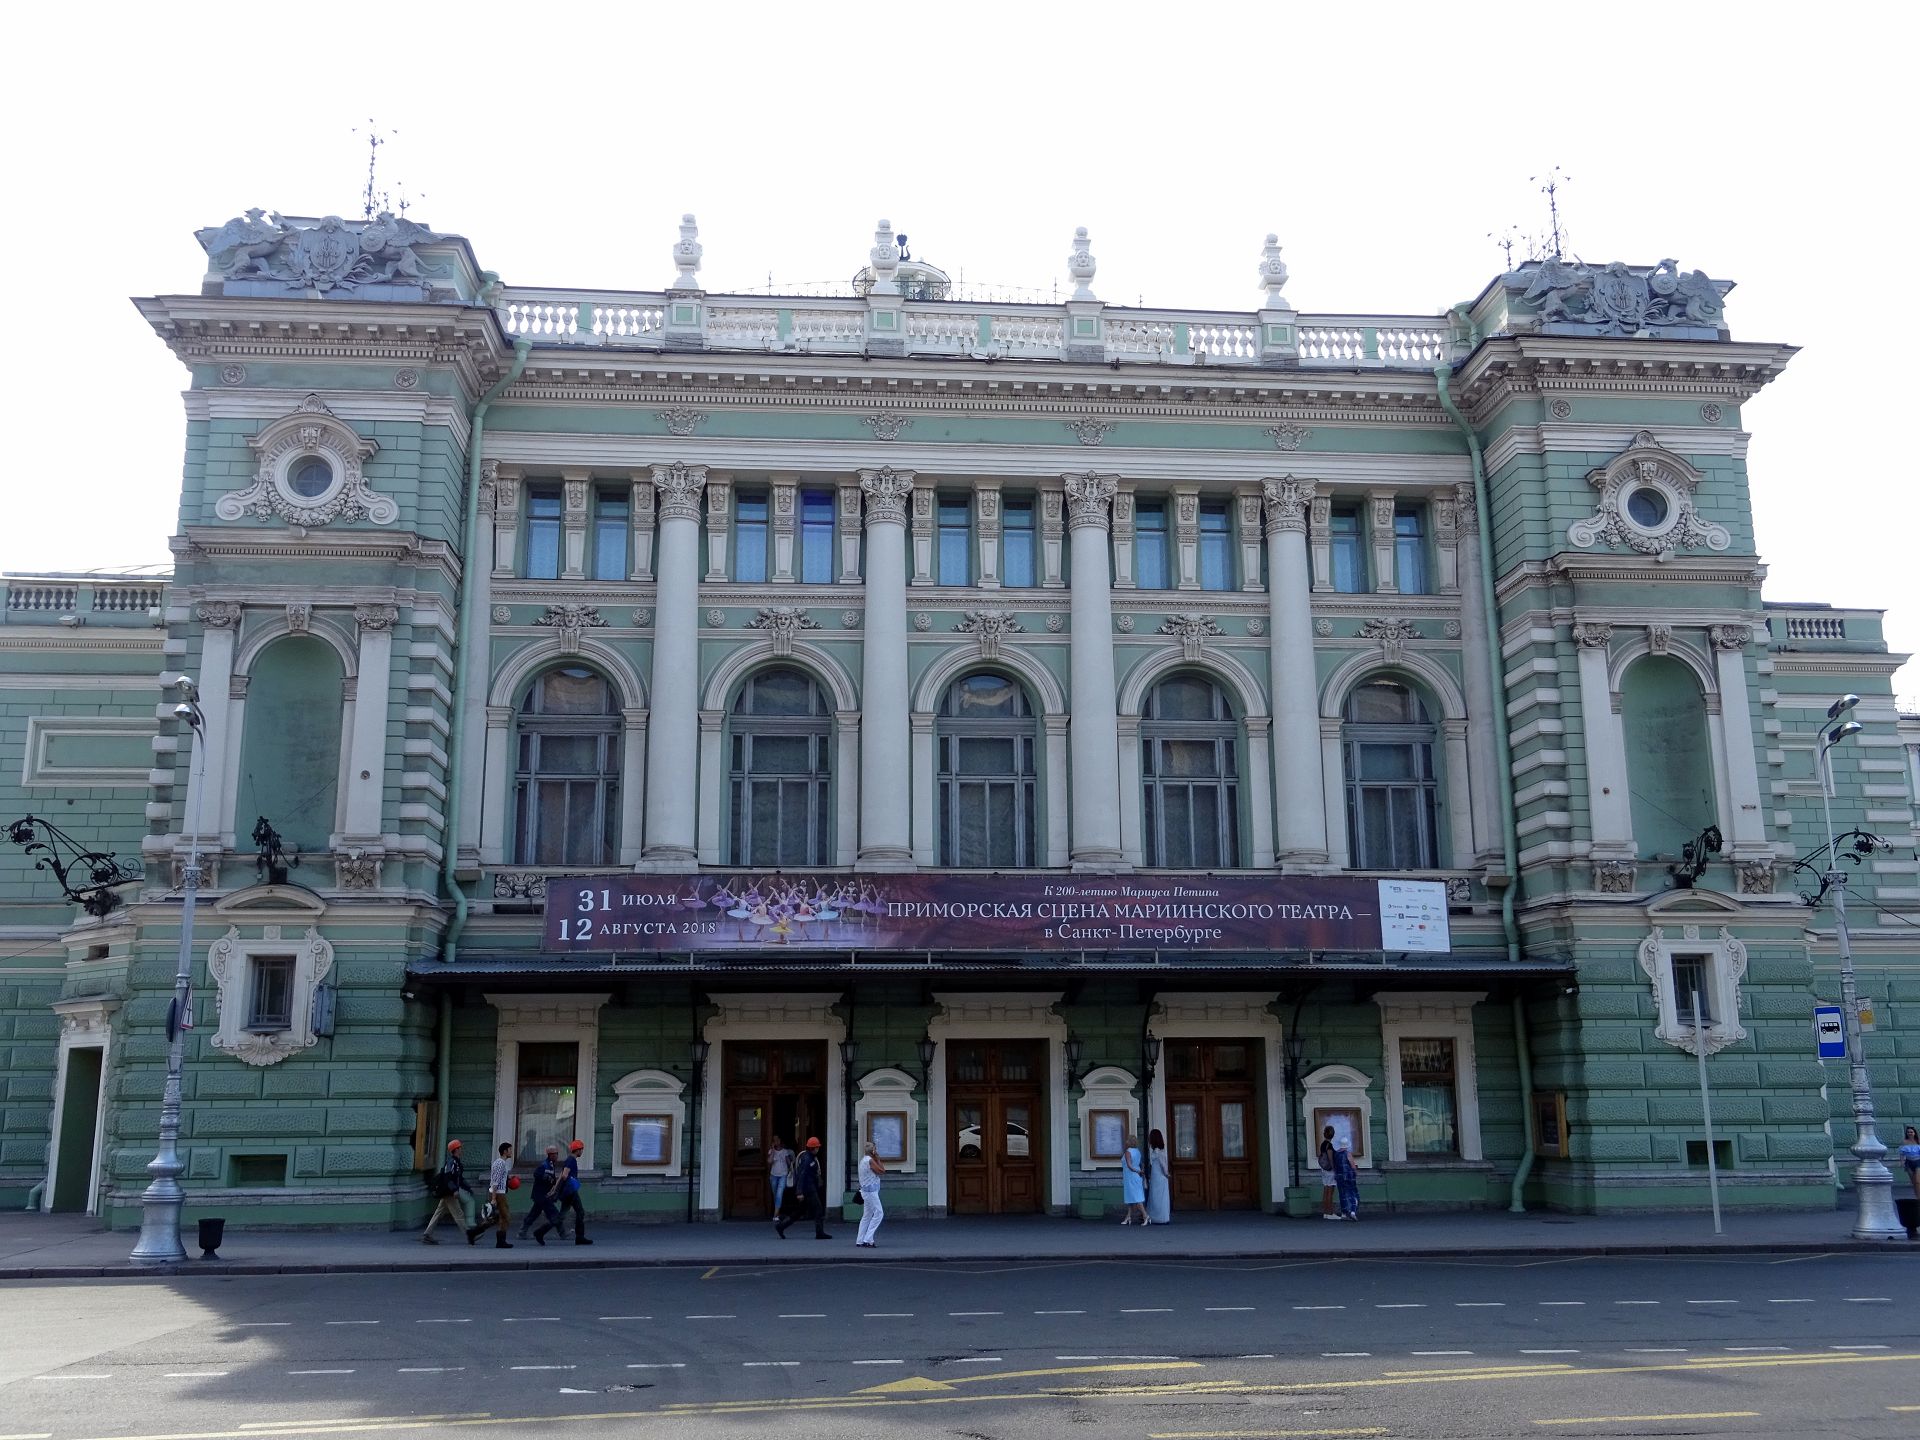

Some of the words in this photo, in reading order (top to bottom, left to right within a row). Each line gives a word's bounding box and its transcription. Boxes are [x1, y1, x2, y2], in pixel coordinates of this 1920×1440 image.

[578, 889, 612, 911] 31
[621, 894, 676, 906] ИЮЛЯ
[1044, 886, 1053, 896] К
[1056, 886, 1117, 897] 200-летию
[1120, 886, 1170, 899] Мариуса
[1173, 887, 1219, 897] Петипа
[887, 902, 1032, 918] ПРИМОРСКАЯ
[1037, 903, 1109, 922] СЦЕНА
[1114, 904, 1273, 919] МАРИИНСКОГО
[1278, 904, 1353, 919] ТЕАТРА
[558, 919, 593, 941] 12
[600, 923, 677, 935] АВГУСТА
[682, 922, 716, 935] 2018
[1045, 928, 1052, 938] в
[1058, 924, 1222, 943] Санкт-Петербурге
